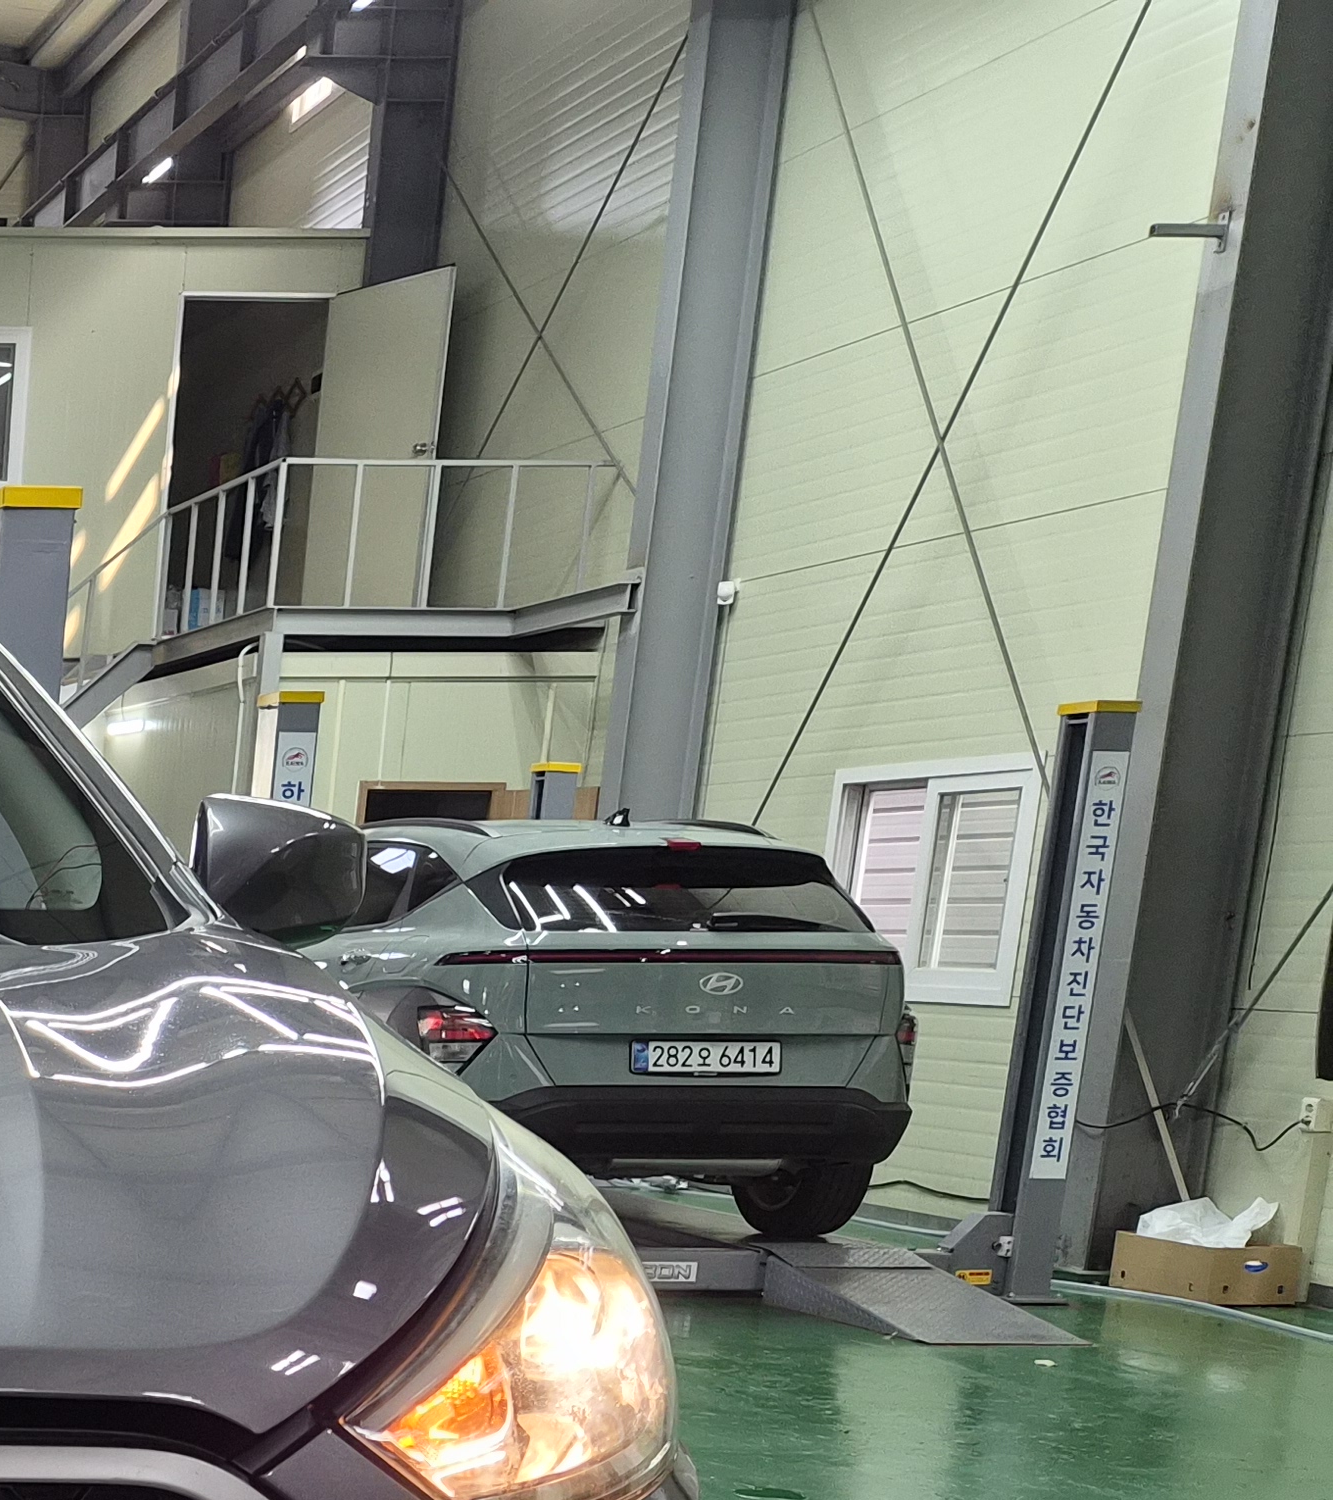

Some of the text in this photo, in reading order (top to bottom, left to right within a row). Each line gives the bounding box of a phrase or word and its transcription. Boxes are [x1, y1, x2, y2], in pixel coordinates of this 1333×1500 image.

[1039, 800, 1116, 1162] 한국자동차진단보증협회
[636, 1005, 795, 1015] KONA
[652, 1045, 775, 1068] 282오 6414
